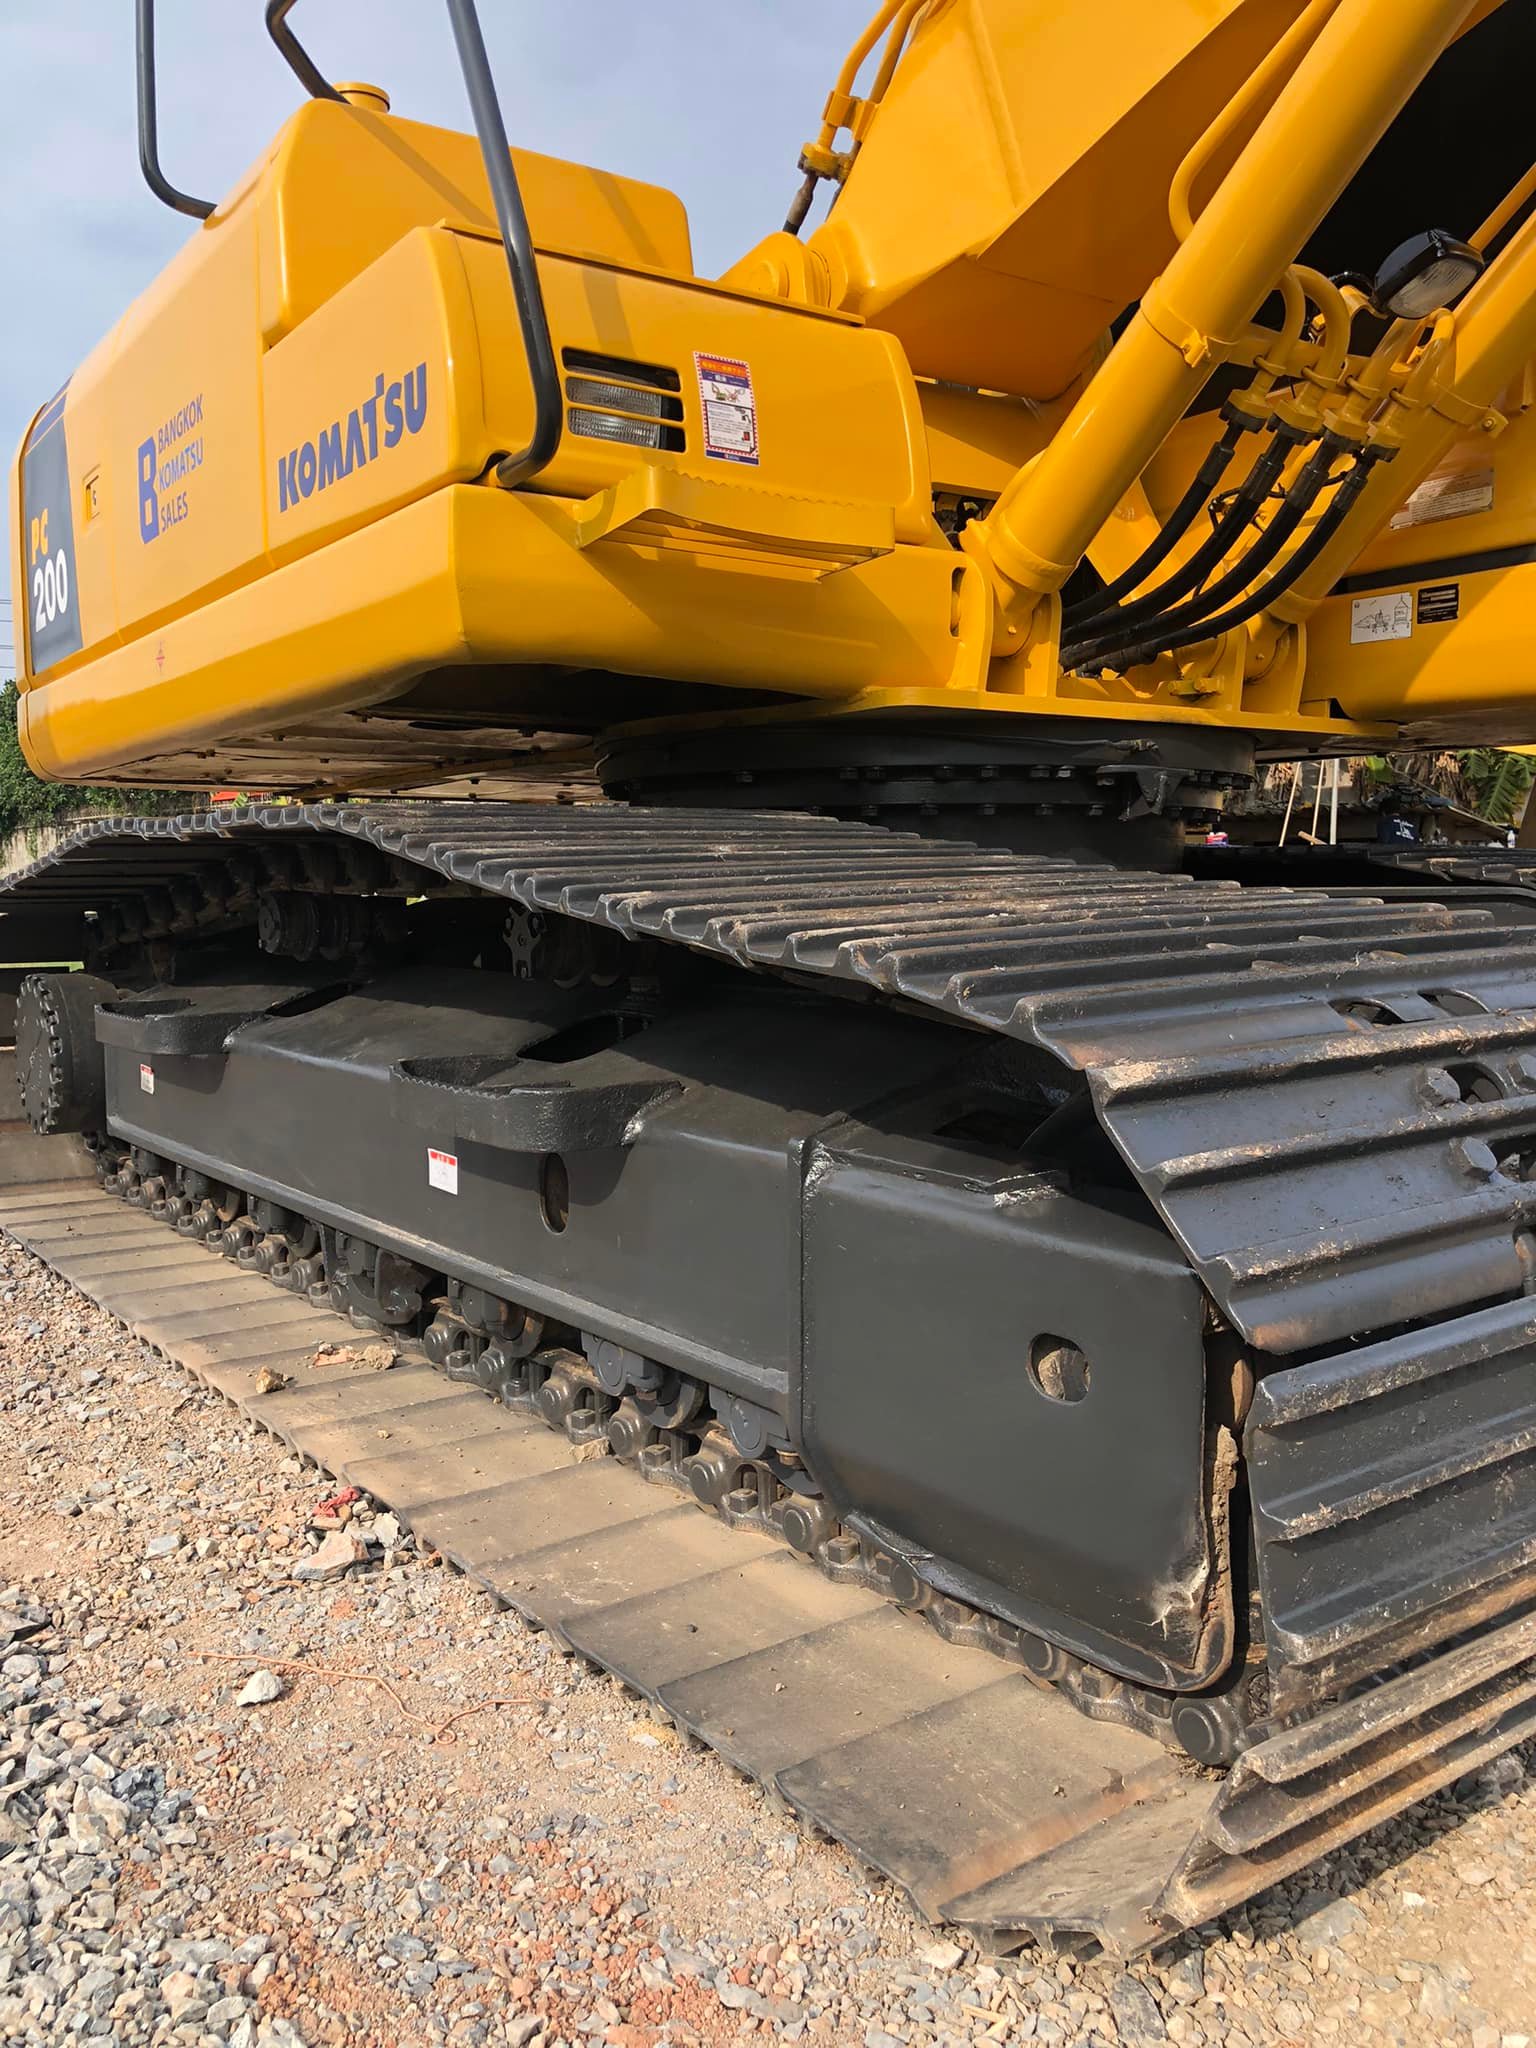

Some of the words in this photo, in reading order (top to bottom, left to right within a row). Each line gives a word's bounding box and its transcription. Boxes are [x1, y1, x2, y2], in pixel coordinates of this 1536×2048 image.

[158, 394, 204, 453] BANGKOK
[278, 362, 427, 512] KOMATSU
[158, 438, 204, 492] KOMATSU
[31, 508, 49, 566] PC
[160, 492, 189, 532] SALES
[33, 548, 68, 633] 200
